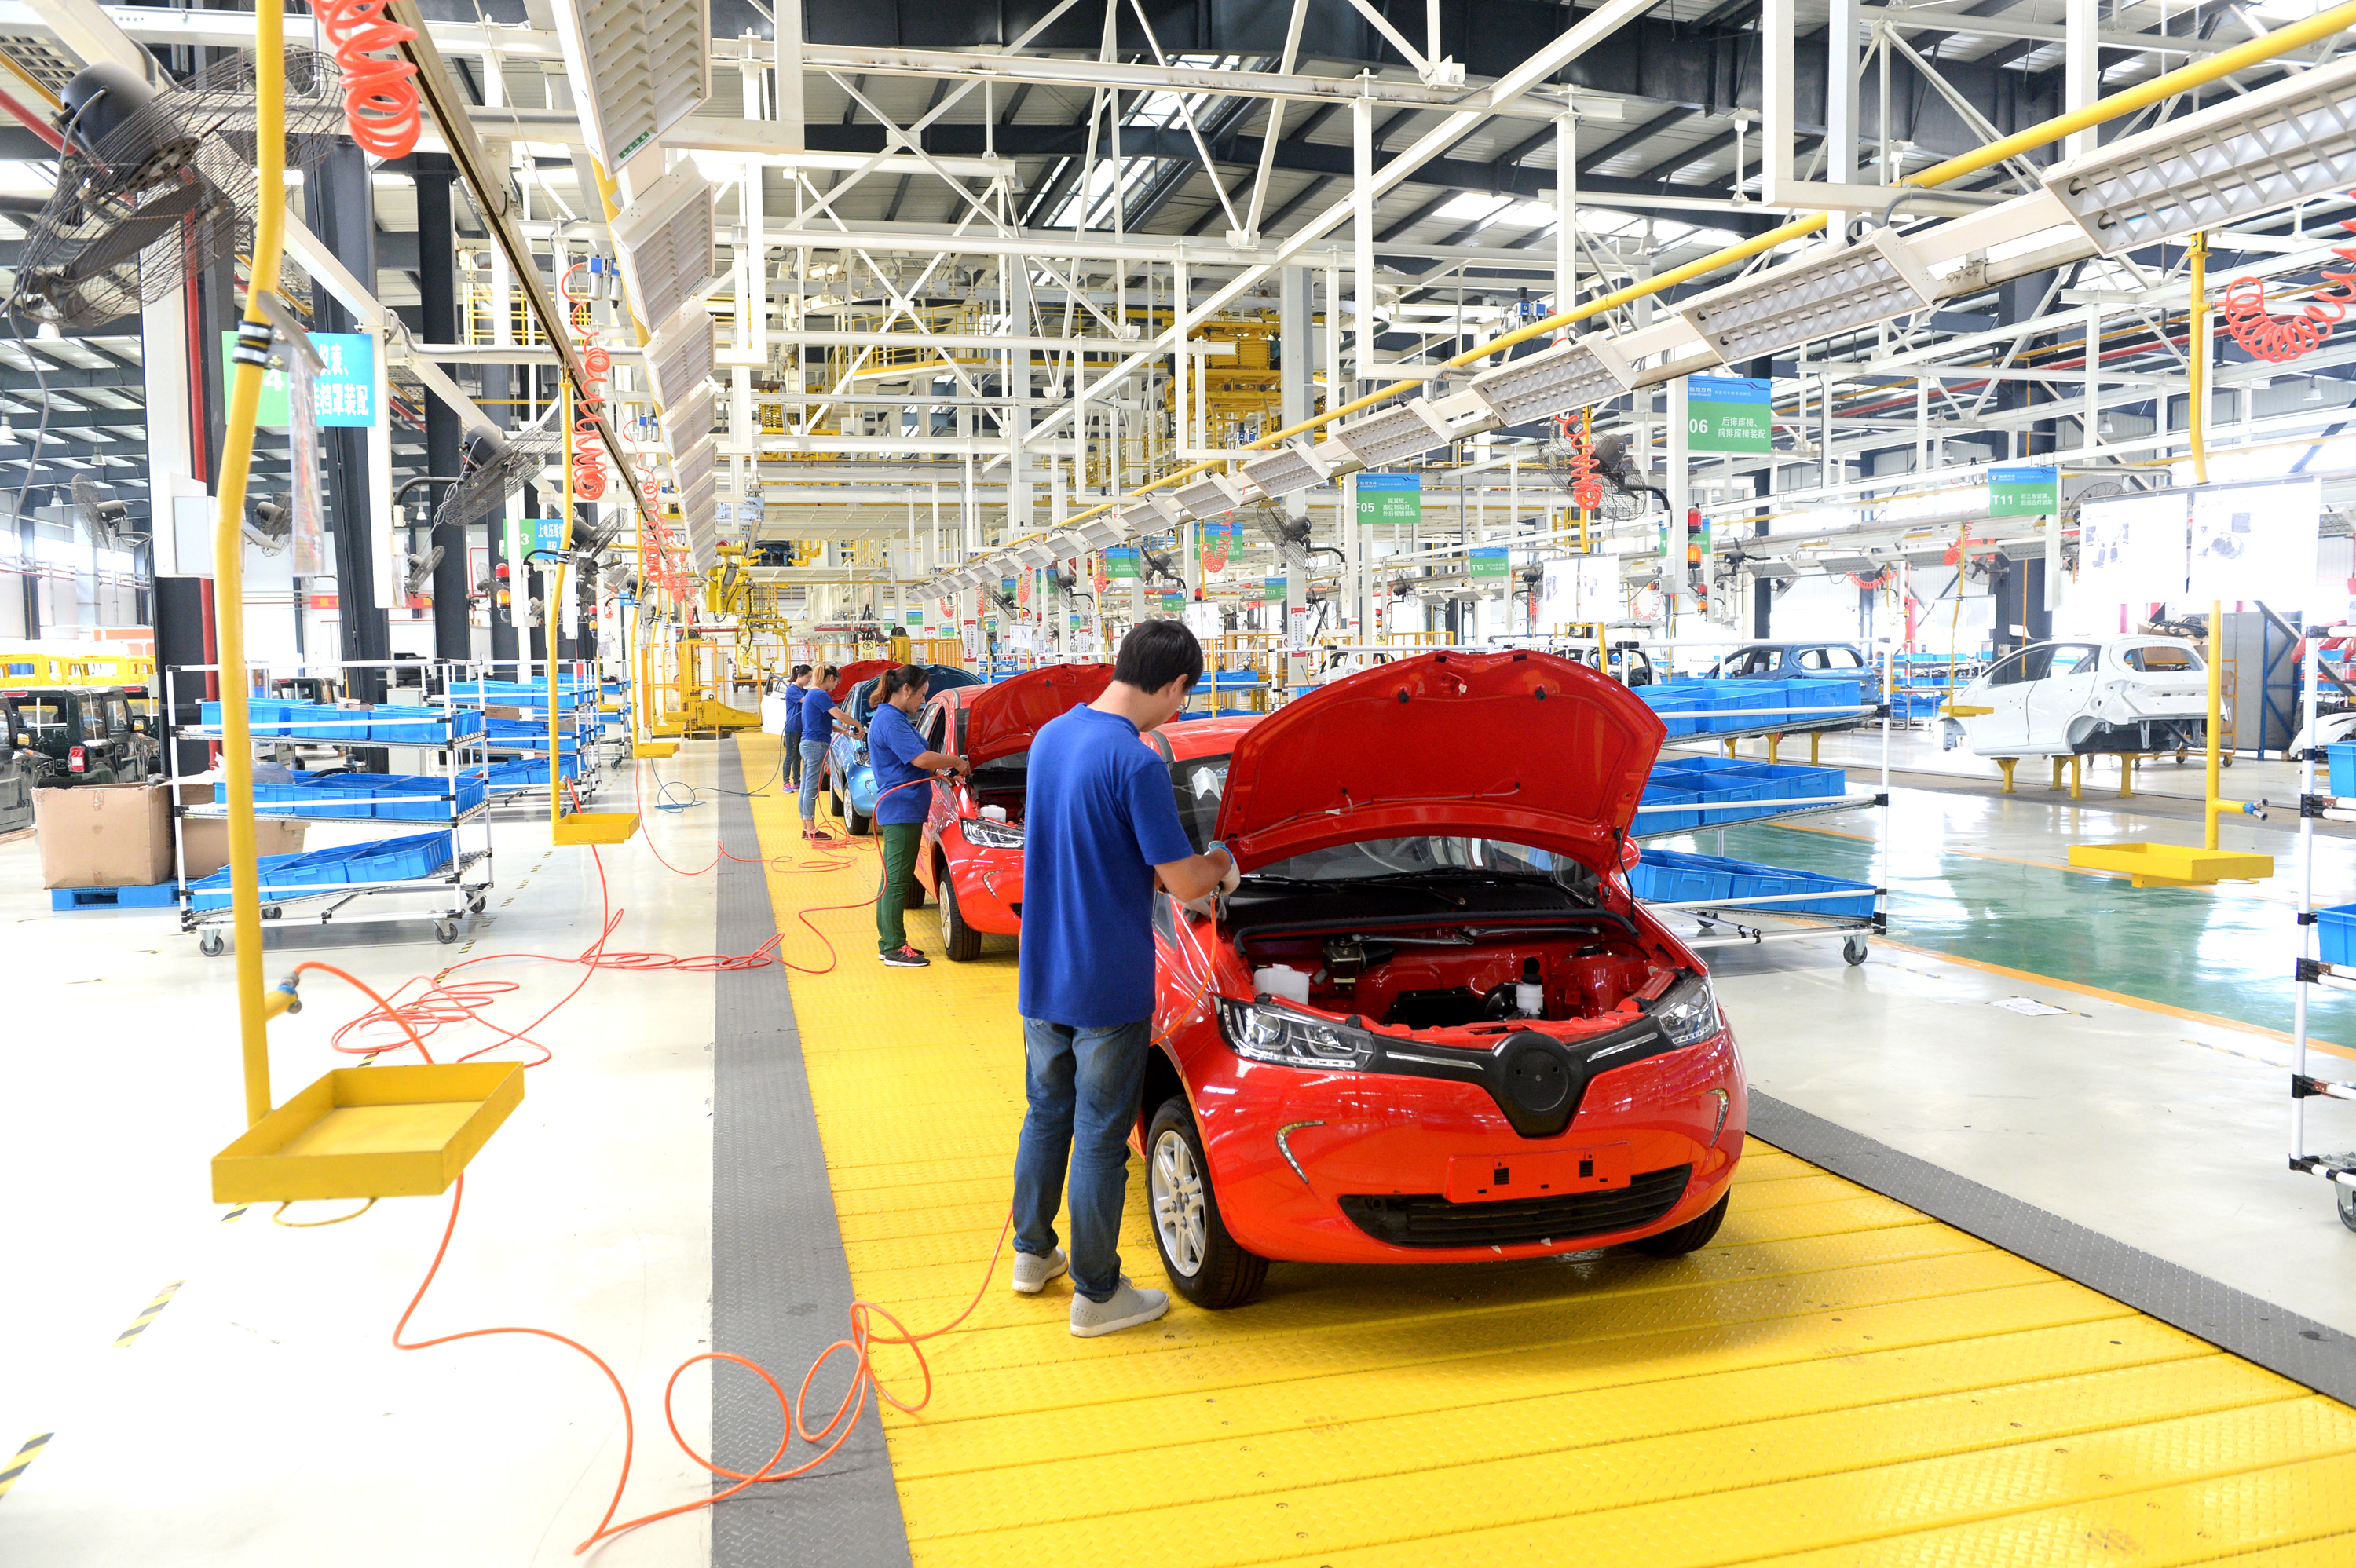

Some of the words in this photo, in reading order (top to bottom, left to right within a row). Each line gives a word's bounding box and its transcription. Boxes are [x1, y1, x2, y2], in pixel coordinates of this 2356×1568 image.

[1689, 418, 1708, 433] 06
[1721, 417, 1759, 428] 后排座椅、
[1718, 428, 1766, 439] 前排座椅装配
[1992, 495, 2013, 505] T11
